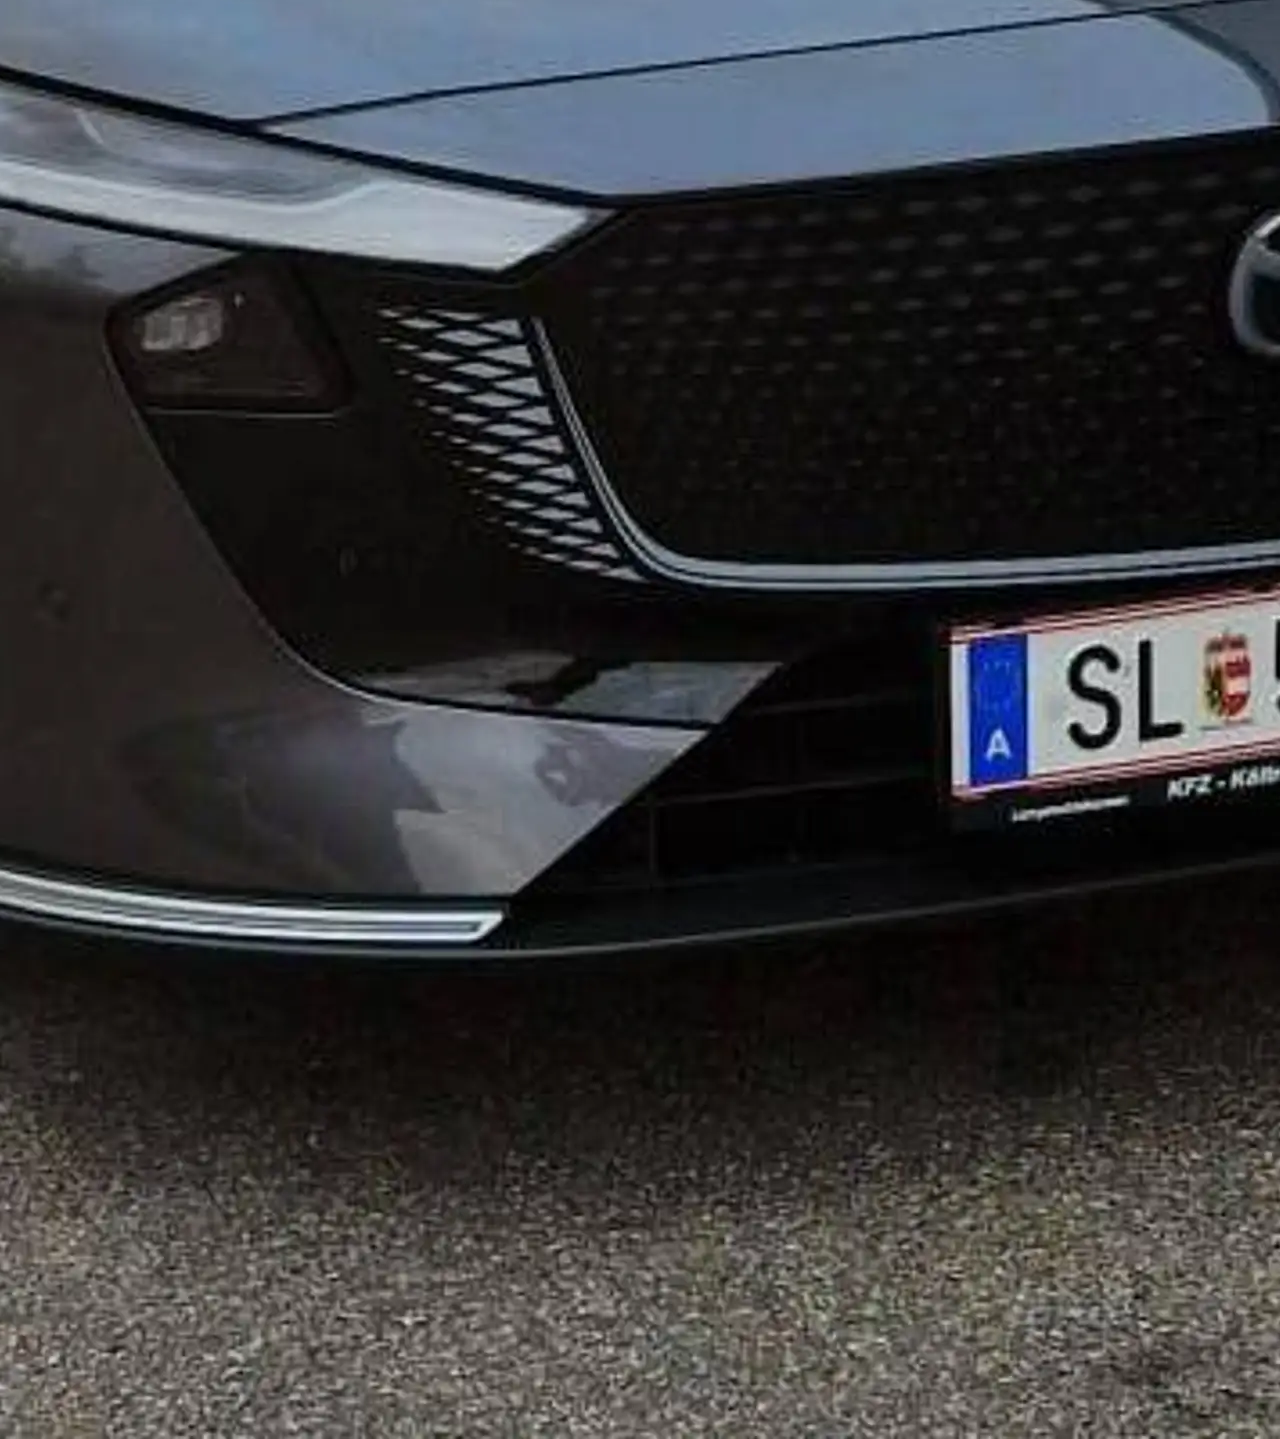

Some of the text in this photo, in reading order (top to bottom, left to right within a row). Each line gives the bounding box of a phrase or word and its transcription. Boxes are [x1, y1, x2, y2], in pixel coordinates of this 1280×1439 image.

[1067, 638, 1183, 750] SL
[985, 726, 1013, 762] A
[1167, 773, 1212, 800] KFZ
